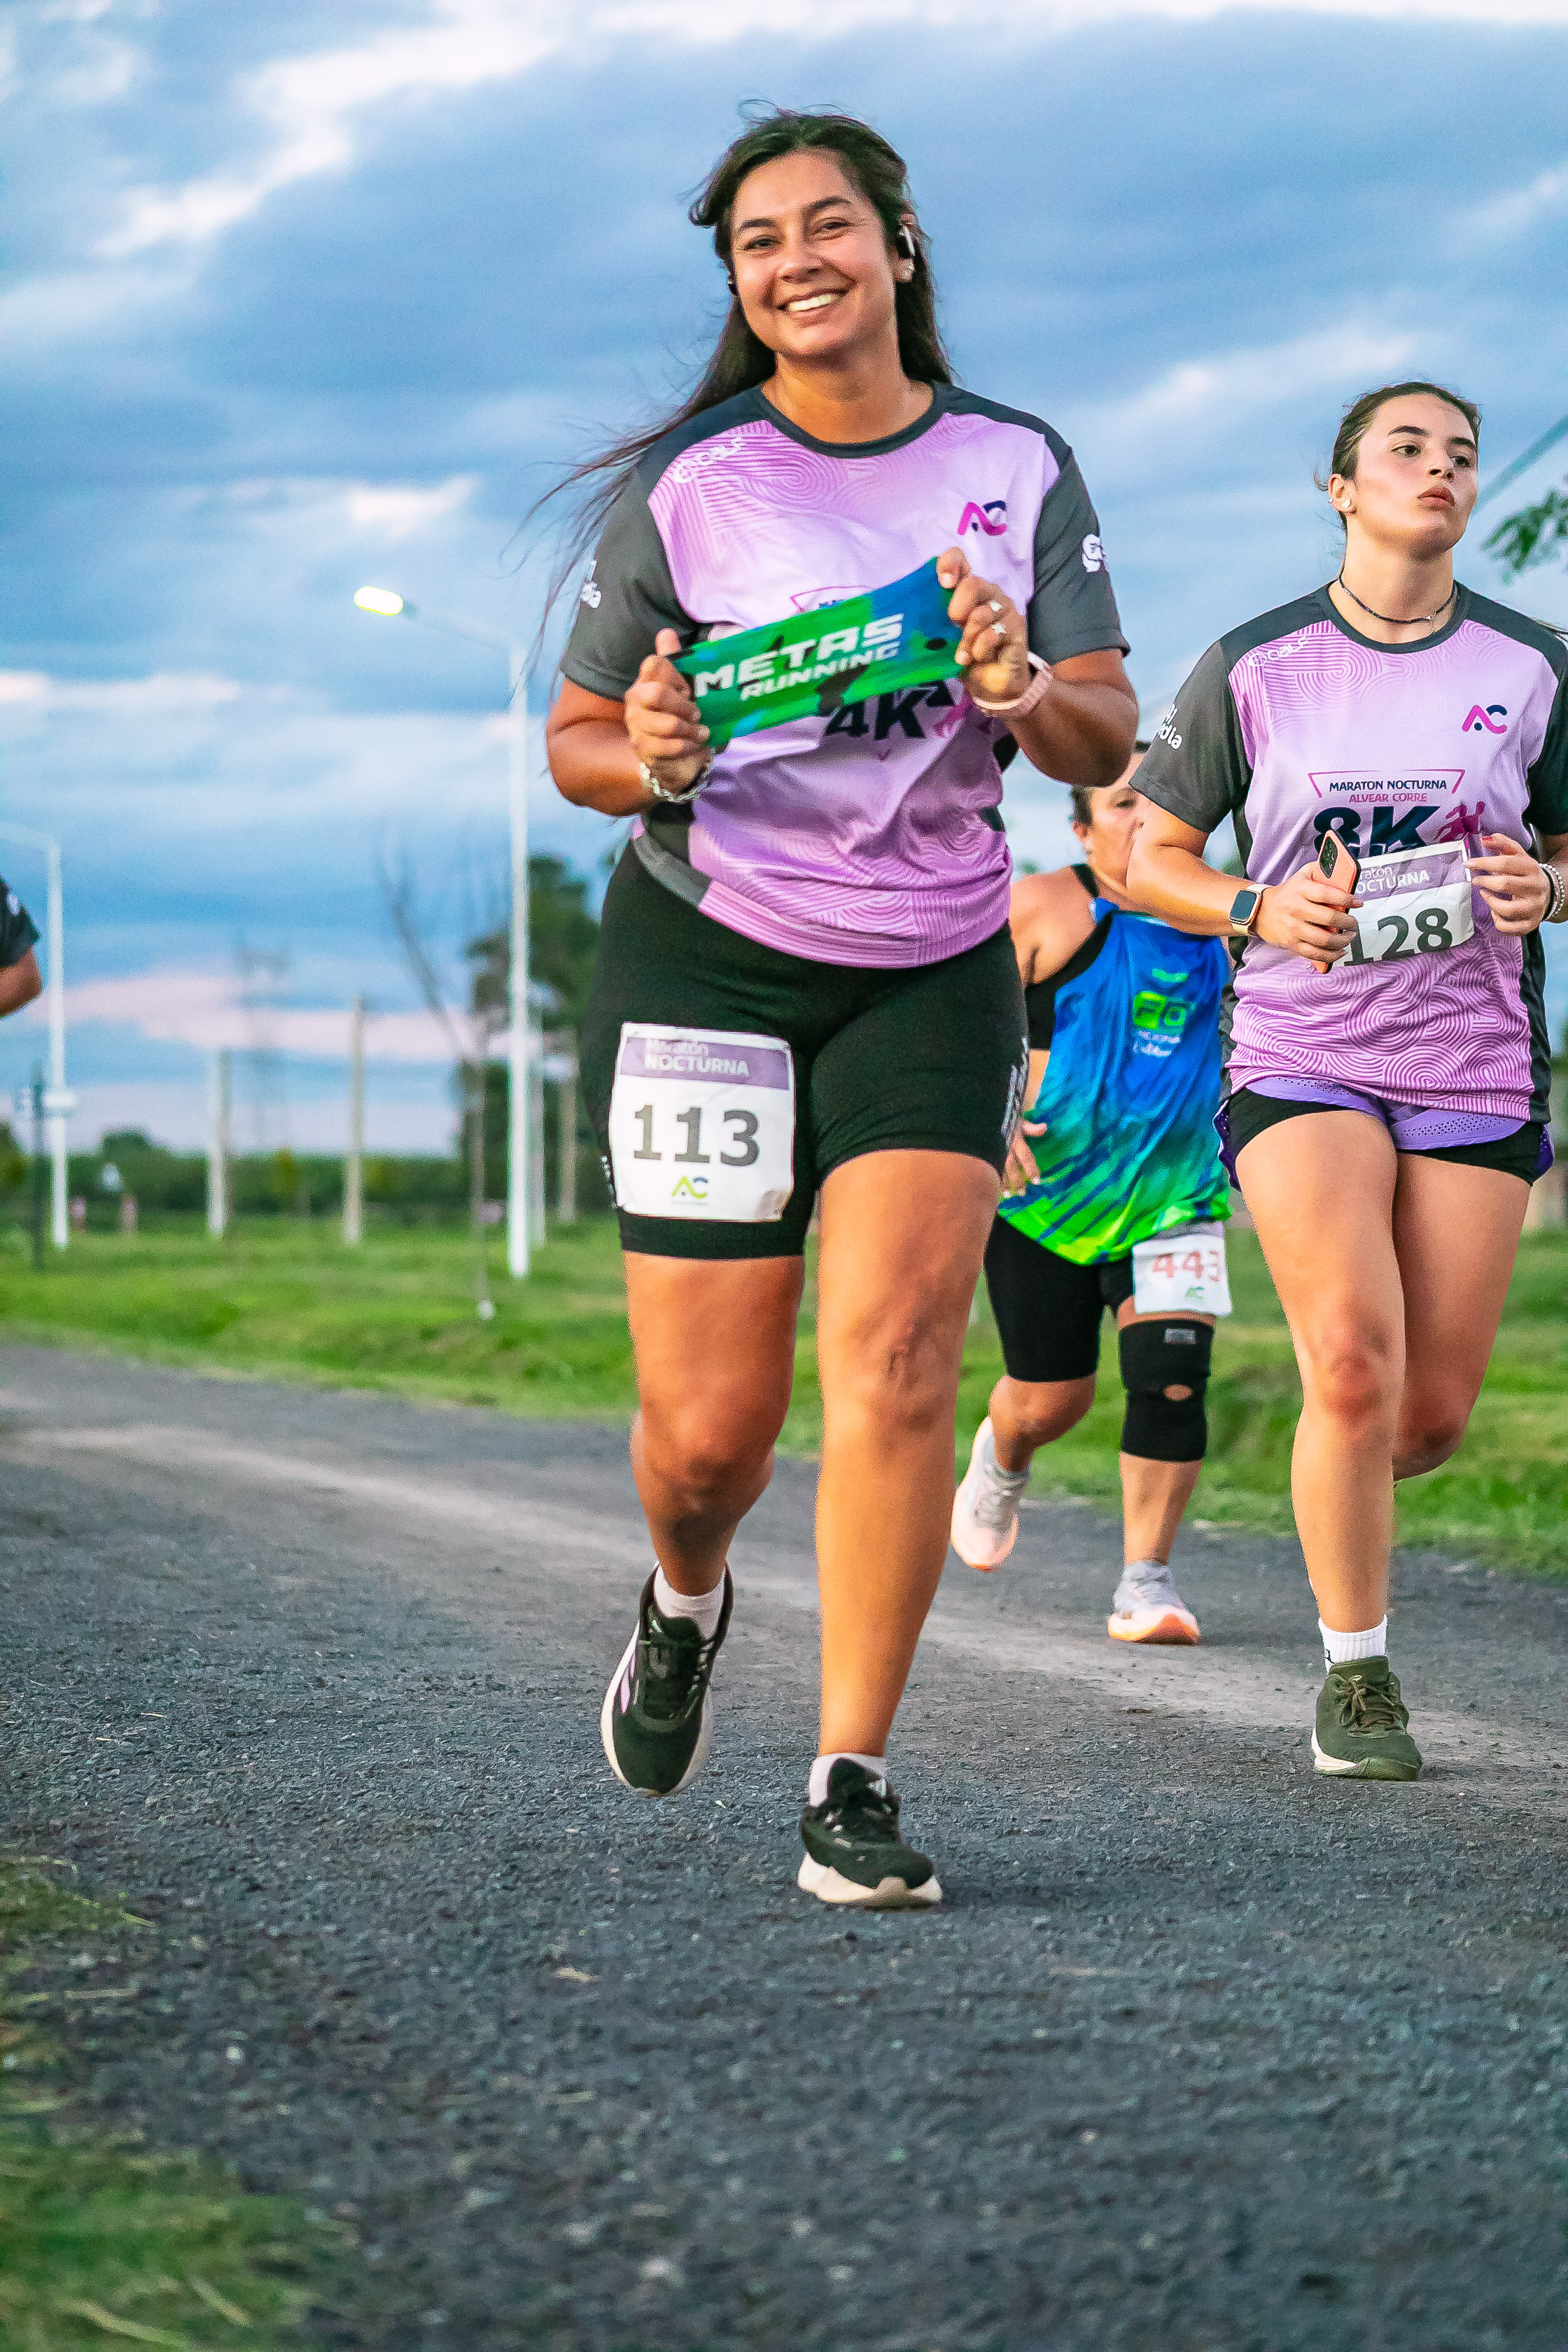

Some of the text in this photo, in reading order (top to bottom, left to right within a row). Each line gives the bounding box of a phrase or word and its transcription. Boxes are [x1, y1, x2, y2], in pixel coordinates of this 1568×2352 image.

[695, 613, 904, 698] METAS
[740, 641, 900, 701] RUNNING
[825, 681, 955, 741] 4K
[1329, 780, 1448, 792] MARATON NOCTURNA
[1349, 792, 1428, 803] ALVEAR CORRE
[1313, 806, 1441, 858] 8K
[1356, 869, 1431, 895] OCTURNA
[1359, 866, 1393, 881] ratón
[1344, 907, 1453, 967] 128
[645, 1052, 750, 1077] NOCTURNA
[634, 1105, 760, 1167] 113
[1152, 1250, 1220, 1283] 443
